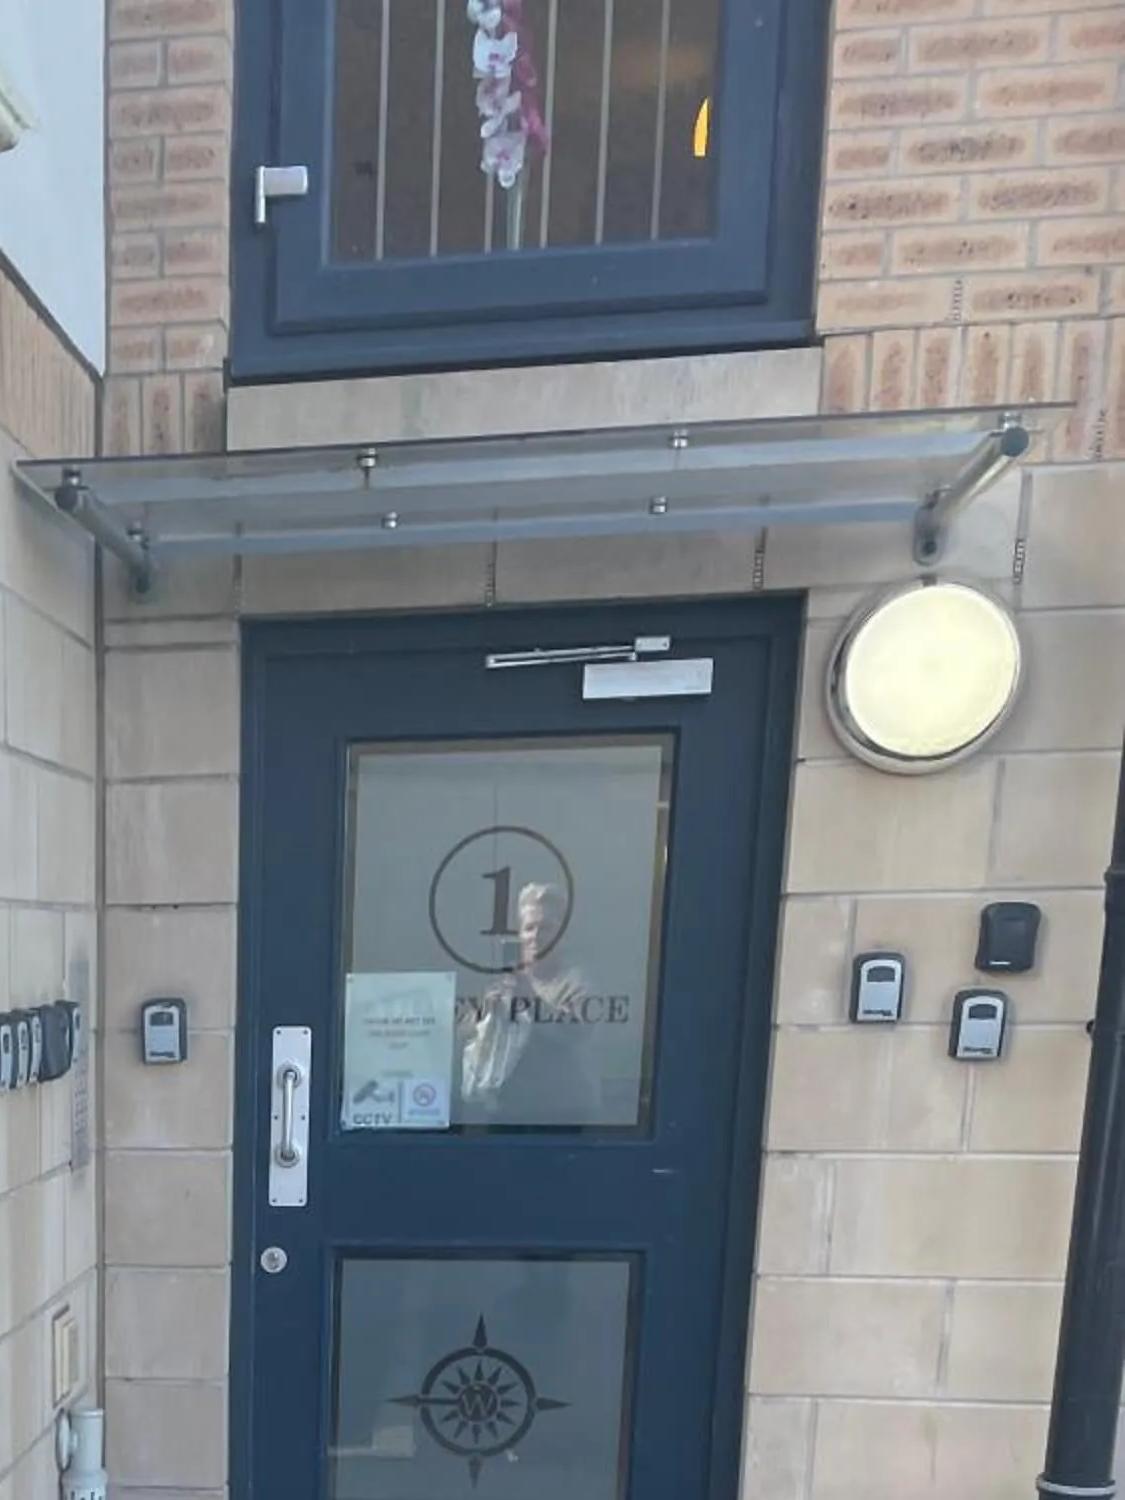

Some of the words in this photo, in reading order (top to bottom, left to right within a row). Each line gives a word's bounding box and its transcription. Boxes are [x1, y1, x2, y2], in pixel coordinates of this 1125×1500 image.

[479, 865, 520, 936] 1
[509, 994, 631, 1024] PLACE
[352, 1111, 393, 1126] CCTV
